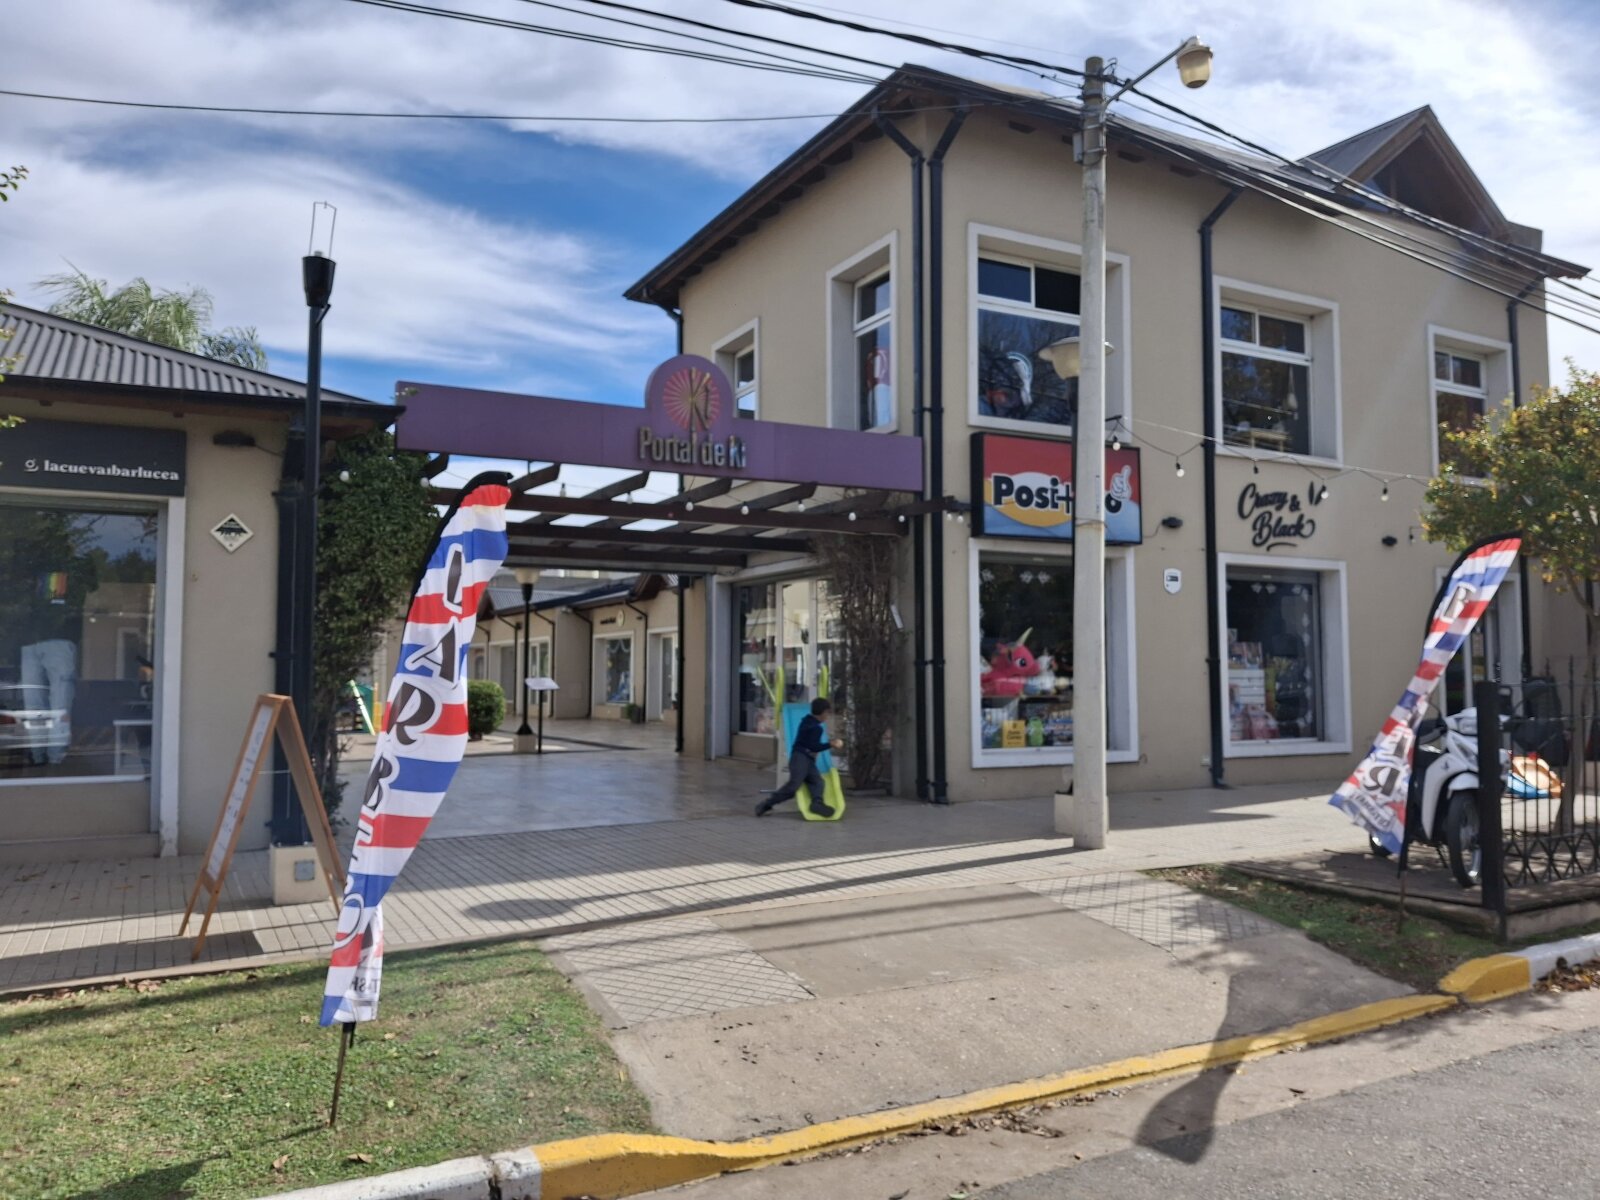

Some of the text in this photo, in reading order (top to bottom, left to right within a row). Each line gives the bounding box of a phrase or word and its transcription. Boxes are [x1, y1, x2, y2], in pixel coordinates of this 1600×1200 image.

[639, 427, 698, 464] Portal
[702, 433, 726, 467] de
[992, 475, 1122, 515] Posito
[1289, 494, 1301, 512] &
[1252, 510, 1316, 547] Black
